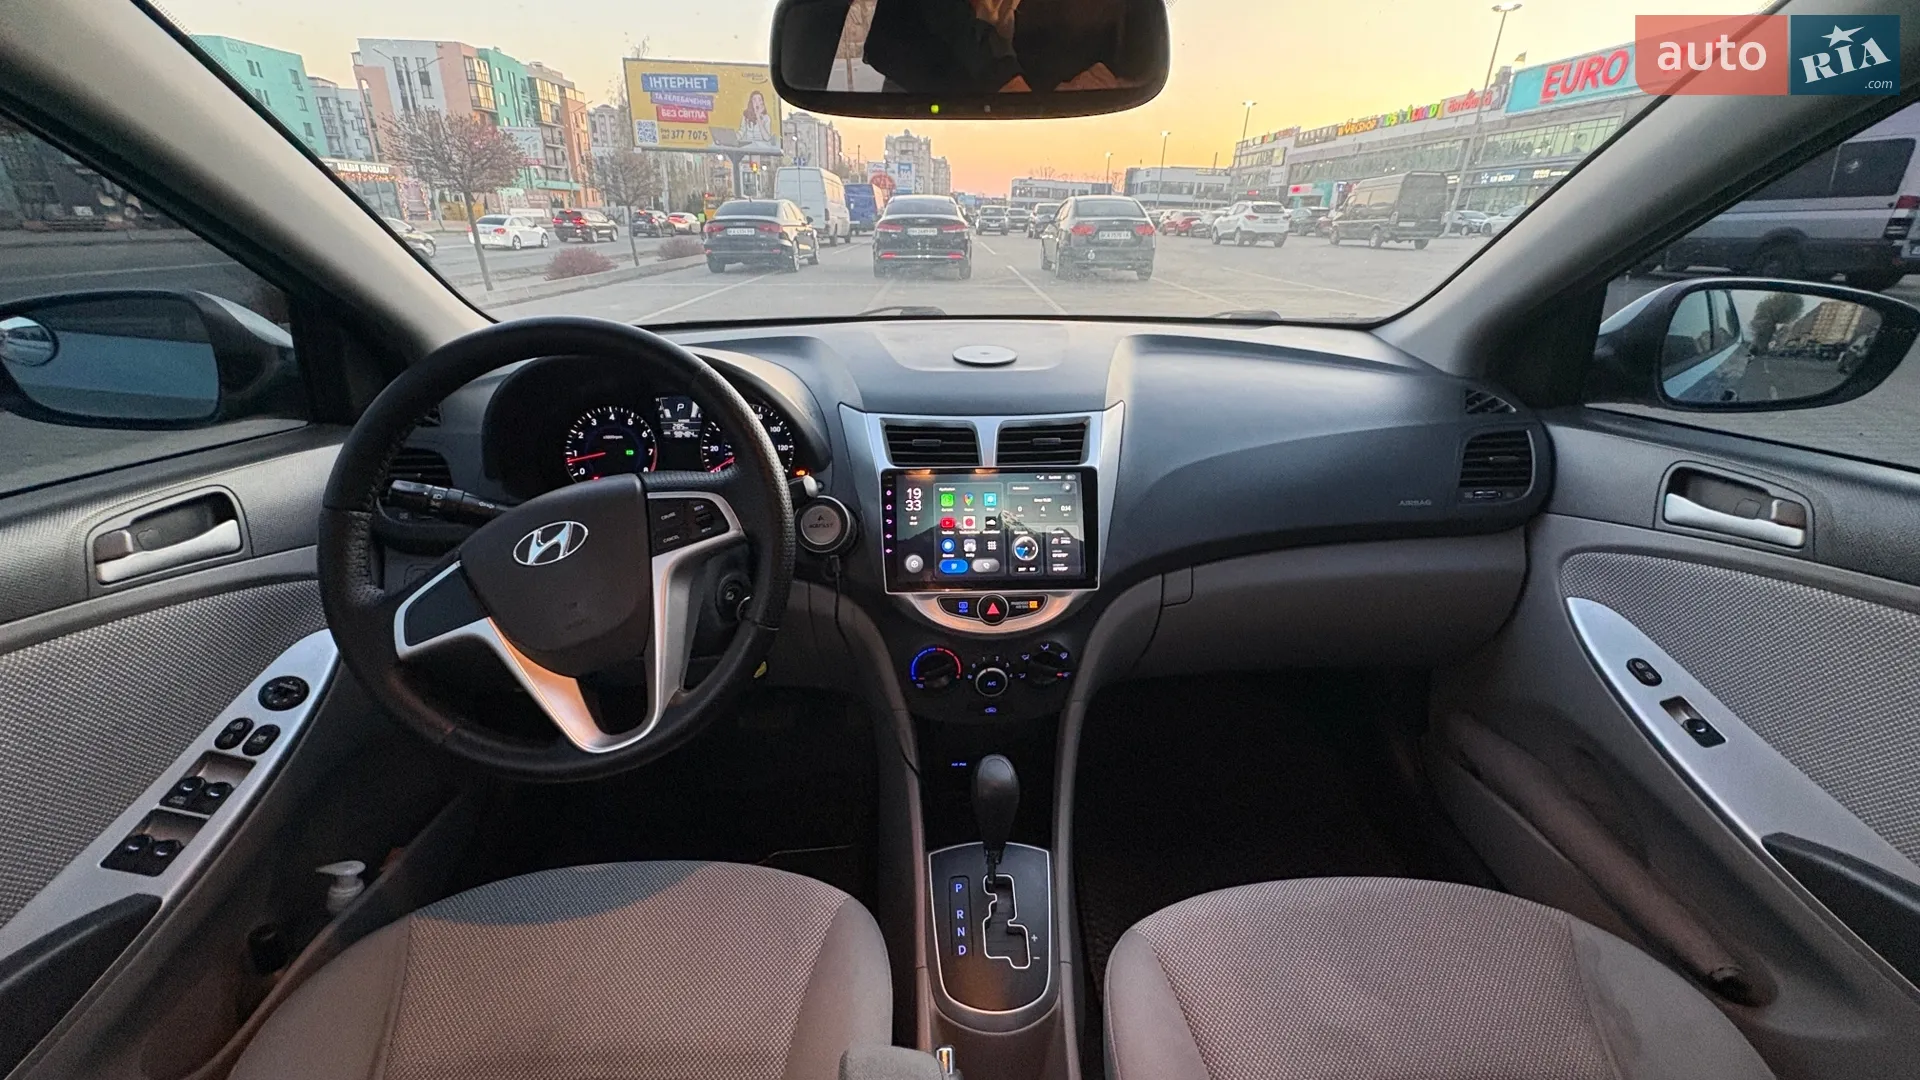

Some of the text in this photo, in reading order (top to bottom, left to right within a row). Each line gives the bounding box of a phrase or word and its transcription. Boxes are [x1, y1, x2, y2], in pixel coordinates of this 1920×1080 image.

[1539, 49, 1630, 104] EURO
[648, 76, 709, 89] ІНТЕРНЕТ
[661, 107, 707, 119] БЕЗ СВІТЛА
[671, 129, 685, 139] 377
[687, 130, 708, 140] 7075
[677, 403, 685, 412] P
[591, 418, 597, 426] 3
[627, 418, 633, 426] 5
[578, 431, 584, 439] 2
[642, 430, 648, 438] 6
[574, 449, 578, 457] 1
[648, 448, 653, 456] 7
[579, 467, 585, 475] 0
[906, 488, 922, 499] 19
[905, 499, 922, 511] 33
[955, 883, 963, 893] P
[956, 909, 964, 919] R
[957, 927, 965, 936] N
[958, 945, 967, 955] D
